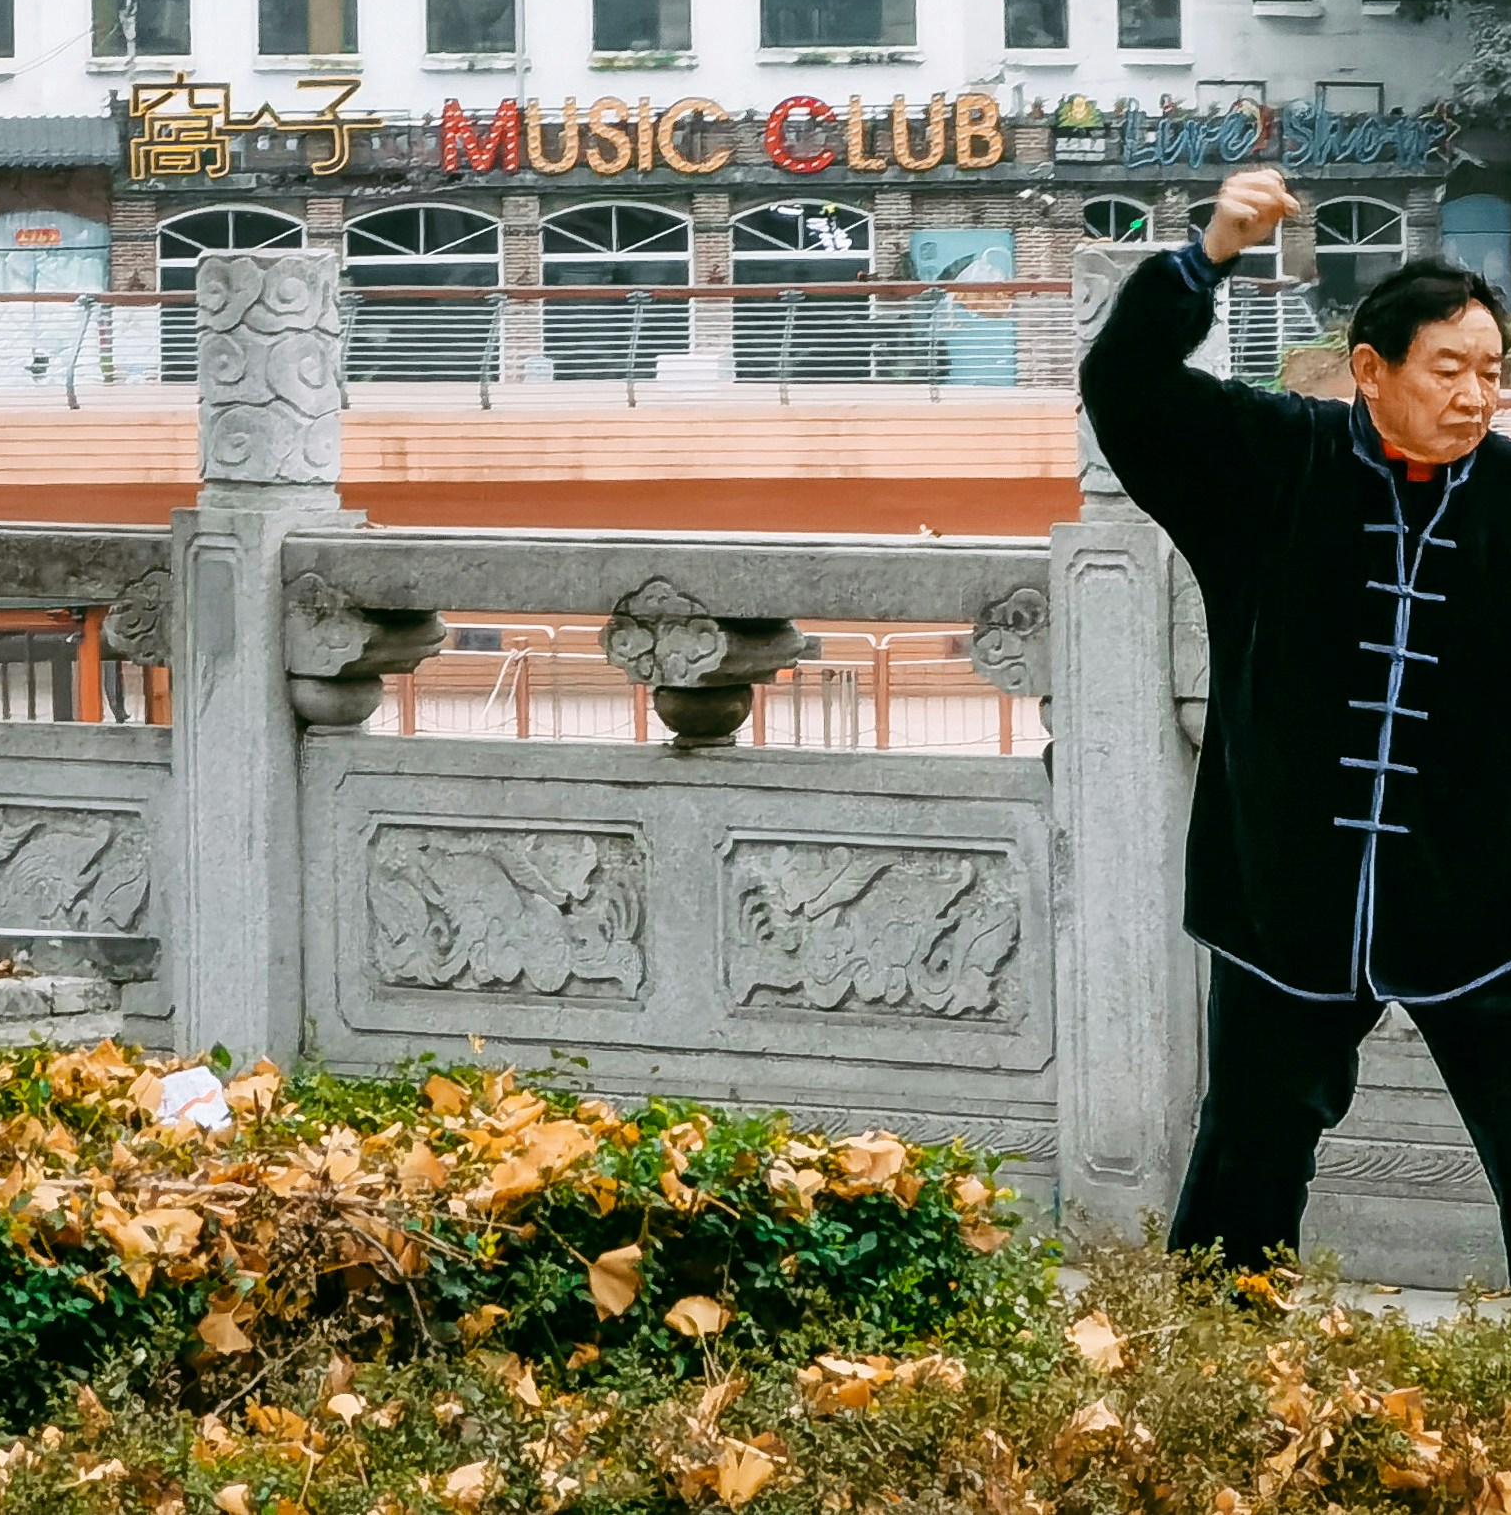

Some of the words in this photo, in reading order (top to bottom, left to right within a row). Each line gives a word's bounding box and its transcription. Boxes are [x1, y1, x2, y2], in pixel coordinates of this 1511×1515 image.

[441, 96, 735, 175] MUSIC
[764, 91, 1005, 174] CLUB
[1122, 97, 1263, 169] Live
[1283, 87, 1447, 169] Show
